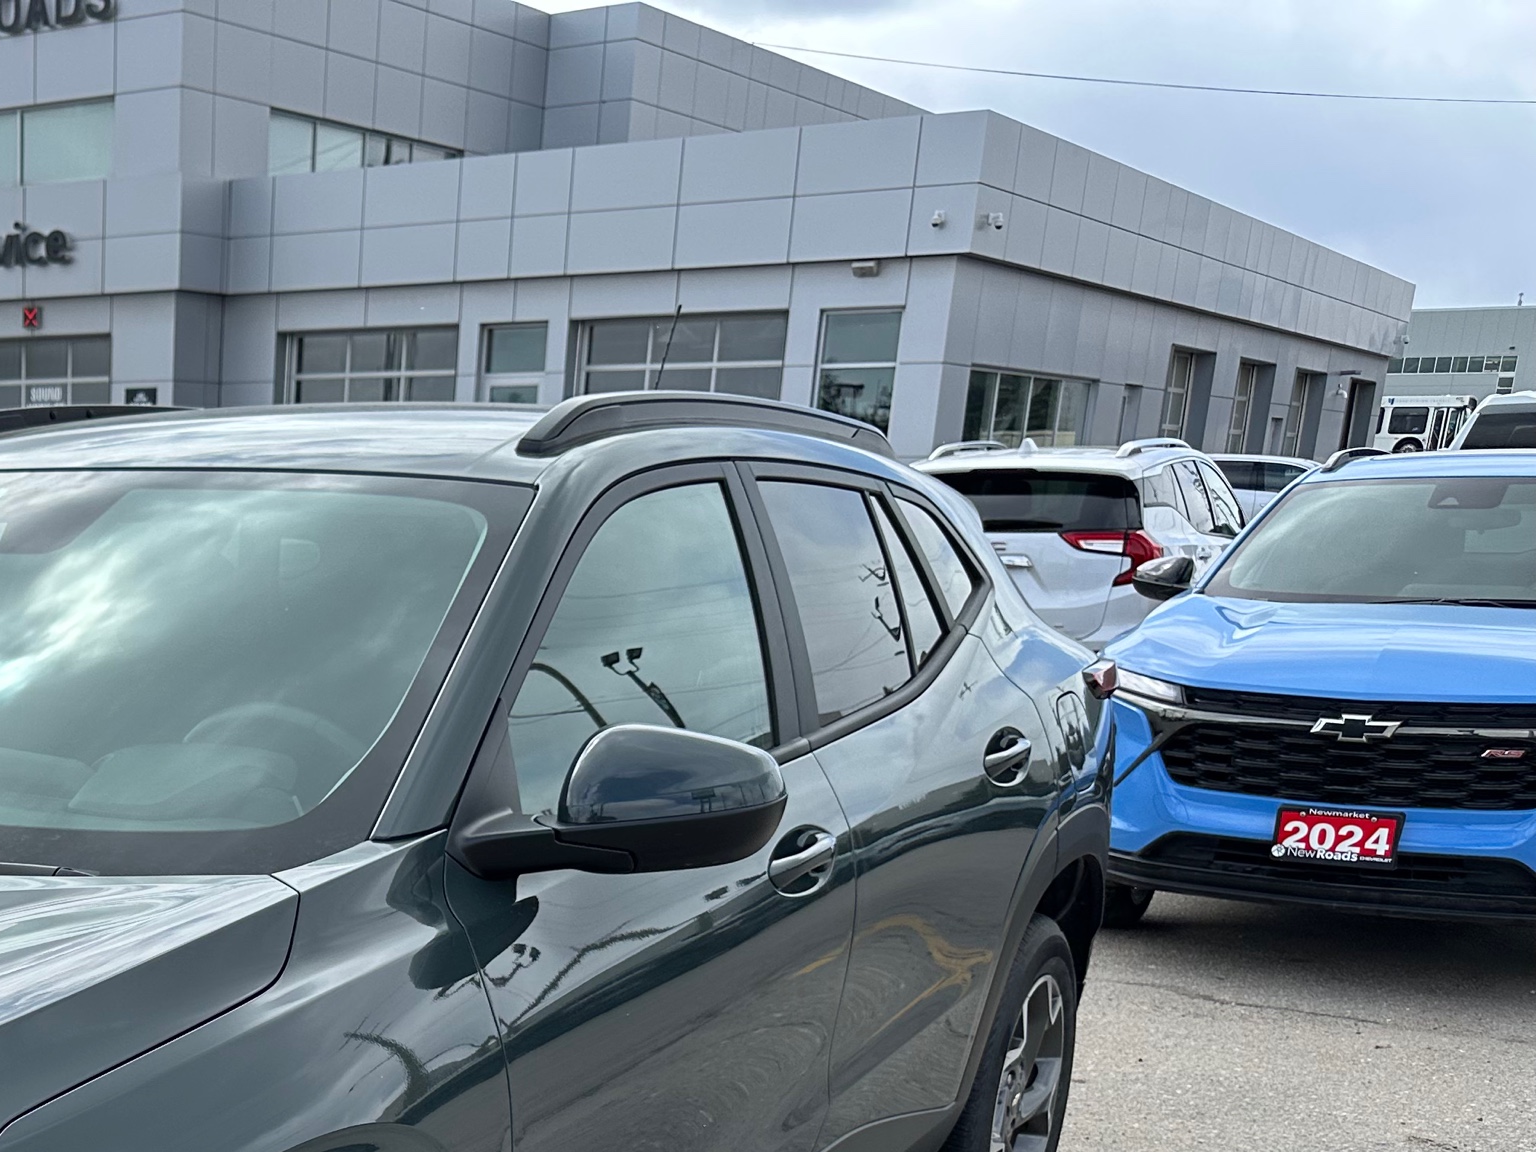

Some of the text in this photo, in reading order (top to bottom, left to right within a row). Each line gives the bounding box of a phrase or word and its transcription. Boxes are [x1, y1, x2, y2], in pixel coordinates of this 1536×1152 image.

[1481, 749, 1526, 758] RS
[1309, 808, 1371, 819] Newmarket
[1282, 821, 1390, 855] 2024
[1287, 846, 1359, 861] NewRoads
